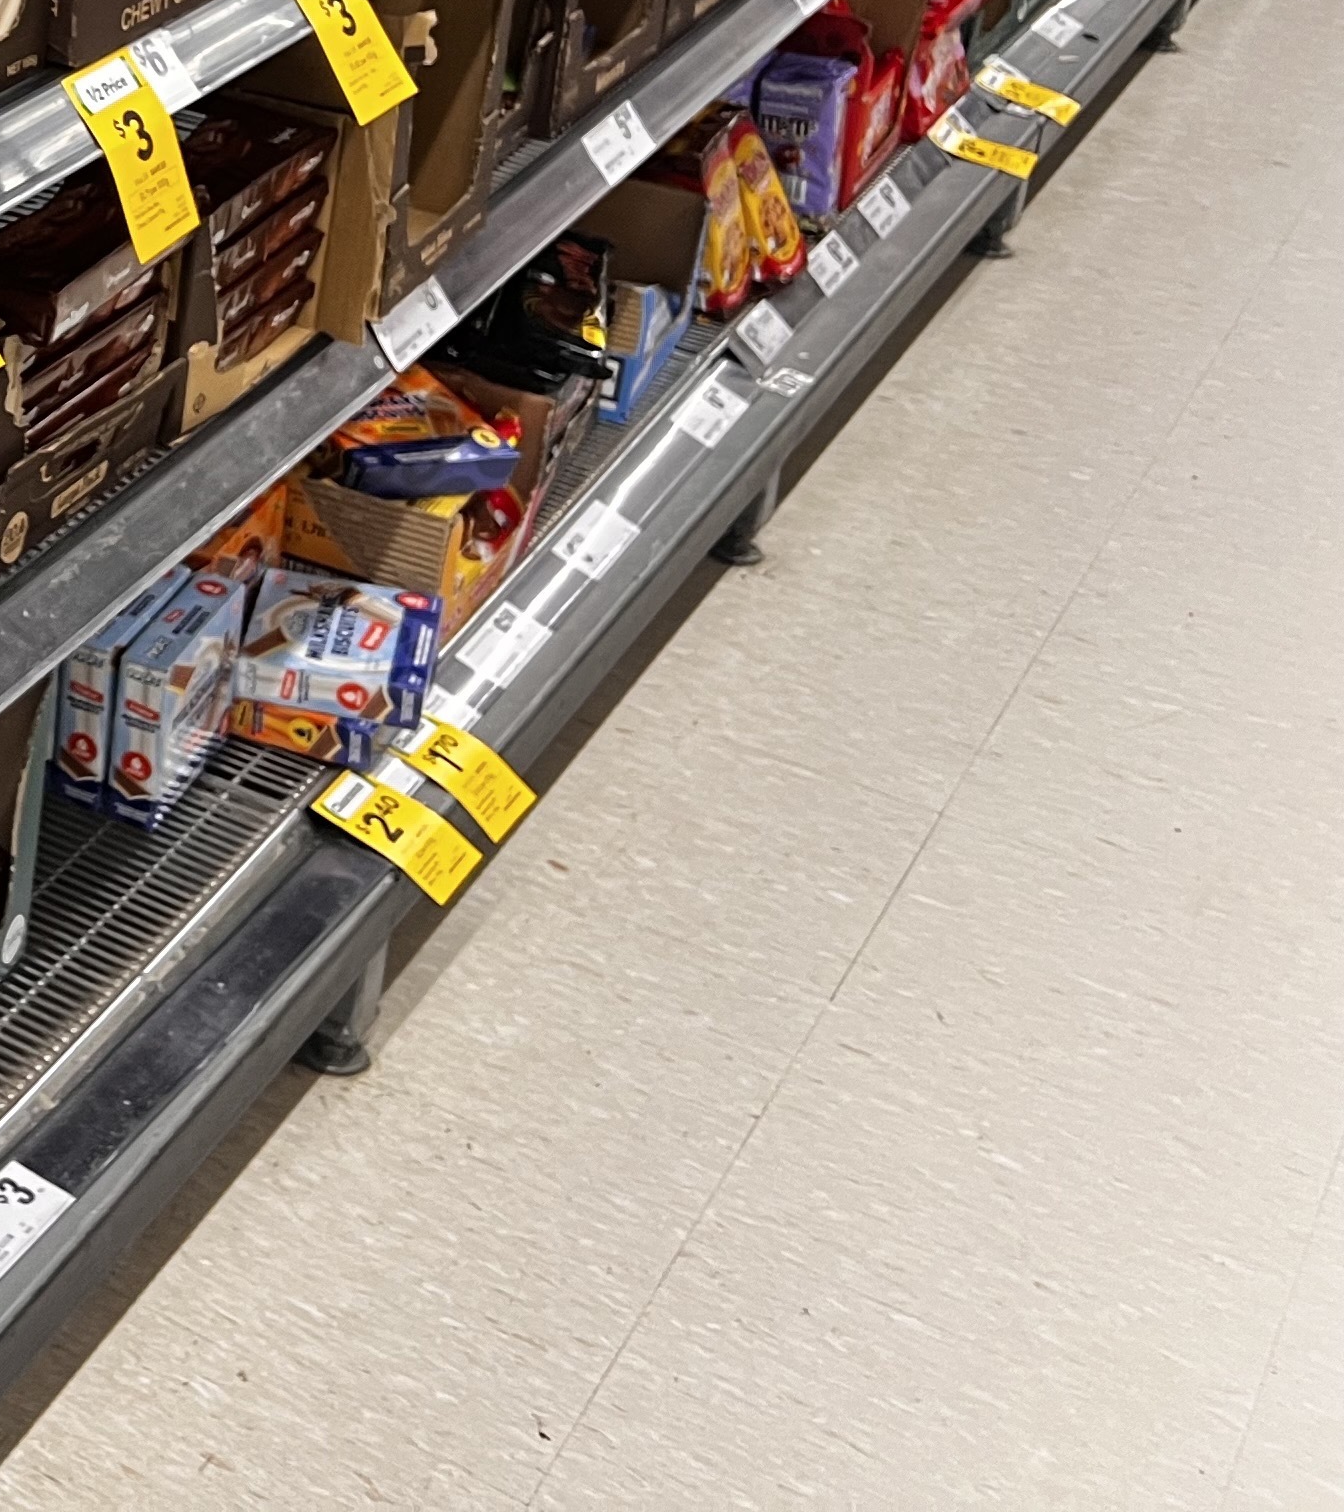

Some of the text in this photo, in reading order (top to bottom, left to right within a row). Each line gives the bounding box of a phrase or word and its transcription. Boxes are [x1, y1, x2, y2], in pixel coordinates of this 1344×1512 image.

[132, 37, 169, 79] $6
[100, 74, 130, 98] Price
[112, 109, 155, 162] $3
